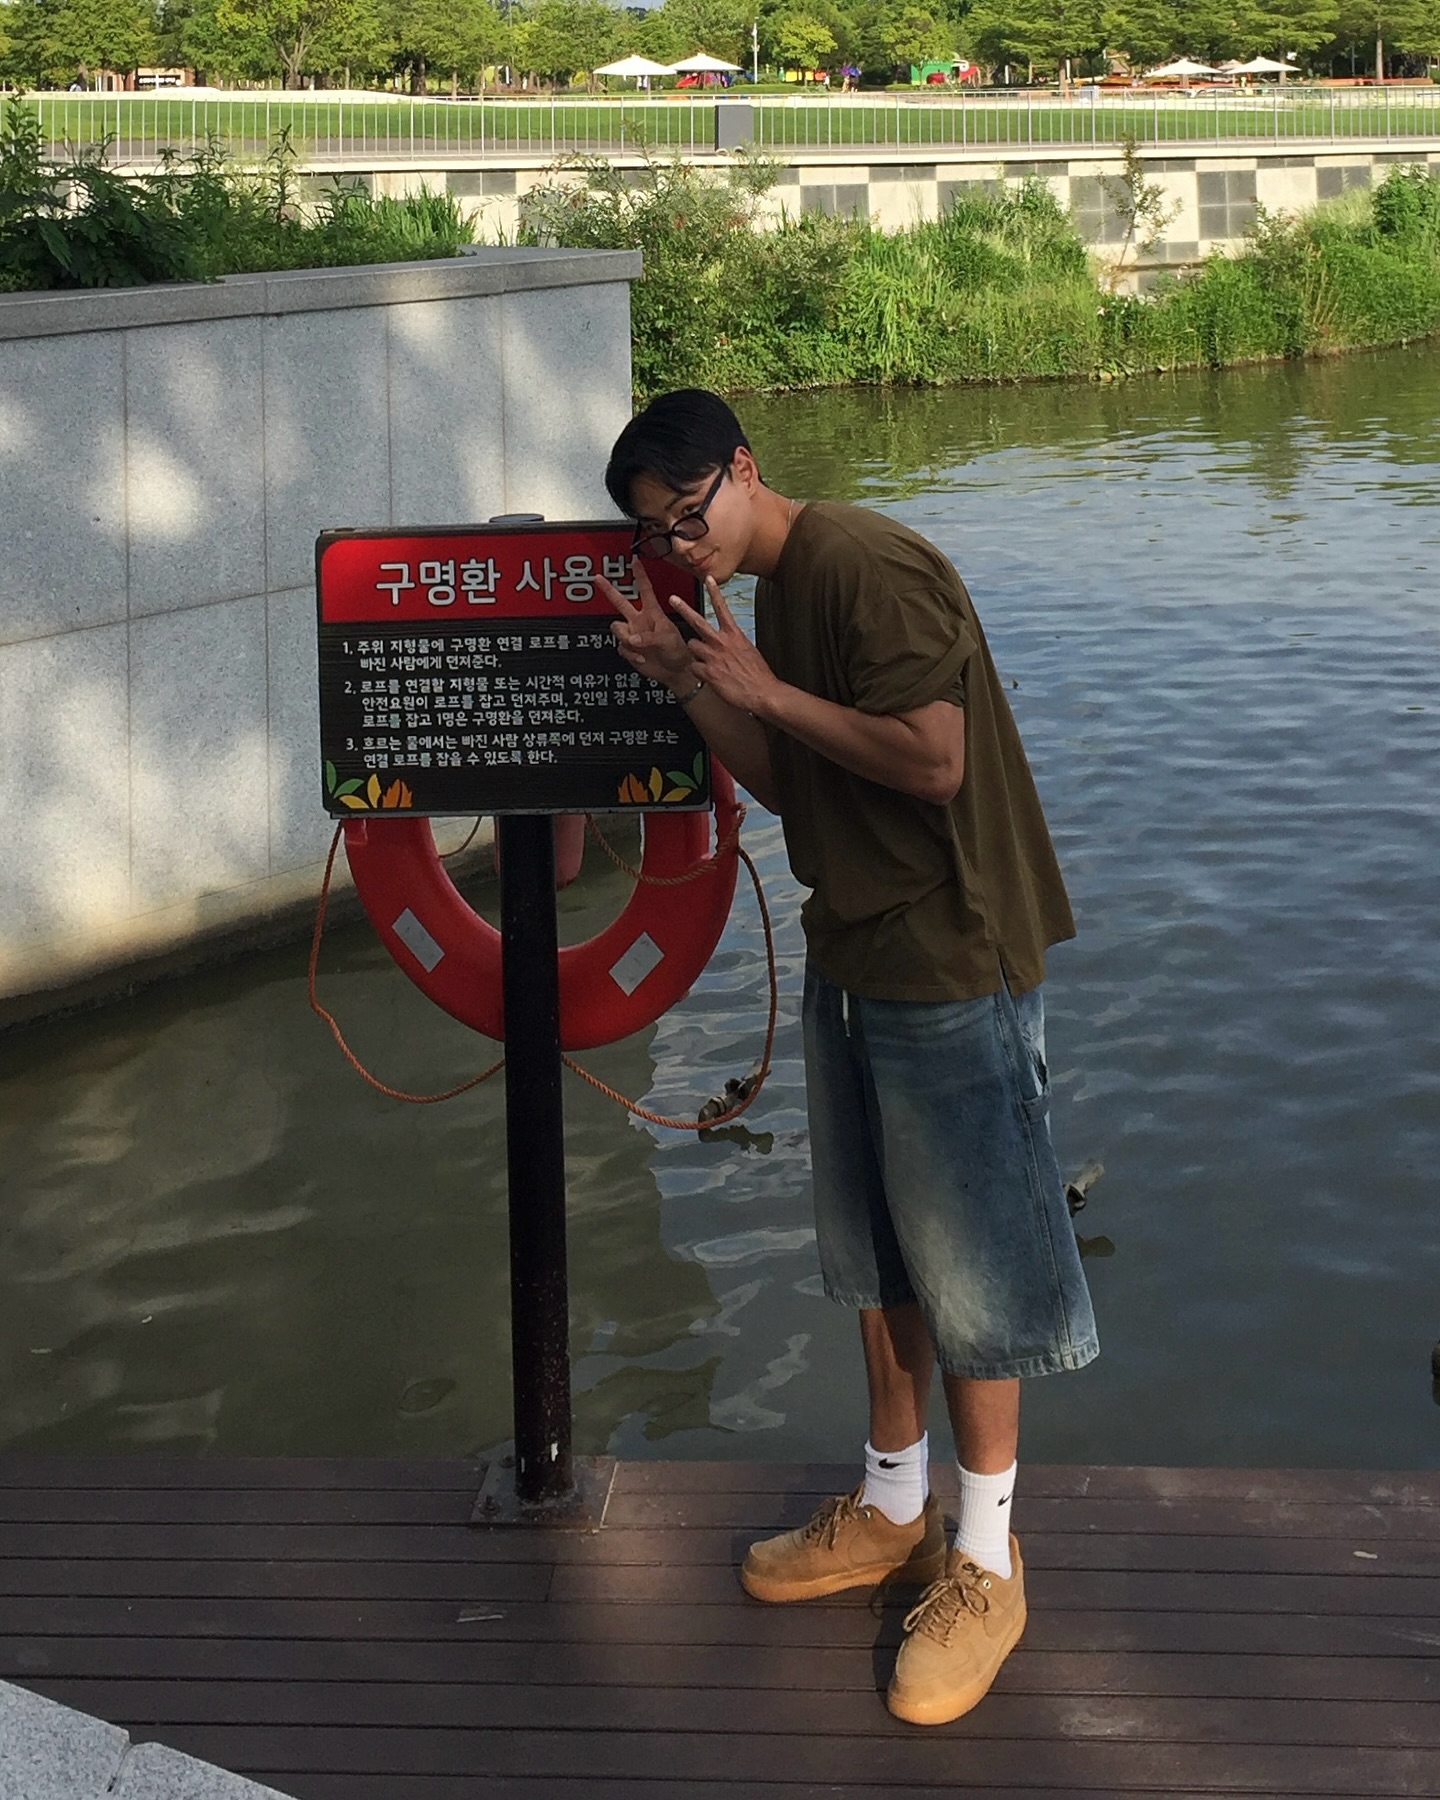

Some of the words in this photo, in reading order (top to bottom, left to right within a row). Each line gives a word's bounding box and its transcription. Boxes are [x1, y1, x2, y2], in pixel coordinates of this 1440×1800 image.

[376, 558, 501, 606] 구명환
[342, 641, 353, 655] 1.
[357, 639, 384, 655] 주위
[390, 638, 445, 654] 지형물에
[450, 636, 492, 653] 구명환
[496, 636, 523, 652] 연결
[529, 634, 570, 650] 로프를
[576, 633, 621, 650] 고정시
[360, 656, 386, 672] 빠진
[390, 656, 442, 671] 사람에게
[344, 680, 356, 695] 2.
[360, 679, 401, 695] 로프를
[405, 677, 445, 694] 연결할
[449, 677, 489, 692] 지형물
[493, 676, 521, 691] 또는
[525, 675, 565, 690] 시간적
[569, 673, 609, 689] 여유가
[614, 672, 641, 689] 없을
[361, 695, 428, 712] 안전요원이
[433, 694, 474, 710] 로프를
[478, 693, 507, 709] 잡고
[574, 691, 608, 706] 2인일
[613, 690, 640, 706] 경우
[362, 713, 402, 729] 로프를
[405, 713, 433, 728] 잡고
[436, 710, 469, 728] 1명은
[472, 710, 524, 727] 구명환을
[346, 737, 359, 751] 3.
[362, 736, 402, 751] 흐르는
[407, 735, 458, 751] 물에서는
[461, 734, 488, 749] 빠진
[491, 733, 519, 748] 사람
[522, 732, 575, 748] 상류쪽에
[608, 730, 649, 746] 구명환
[652, 729, 679, 744] 또는
[363, 753, 389, 769] 연결
[392, 752, 433, 768] 로프를
[436, 751, 463, 767] 잡을
[466, 751, 480, 766] 수
[484, 750, 522, 766] 있도록
[527, 749, 558, 765] 한다.
